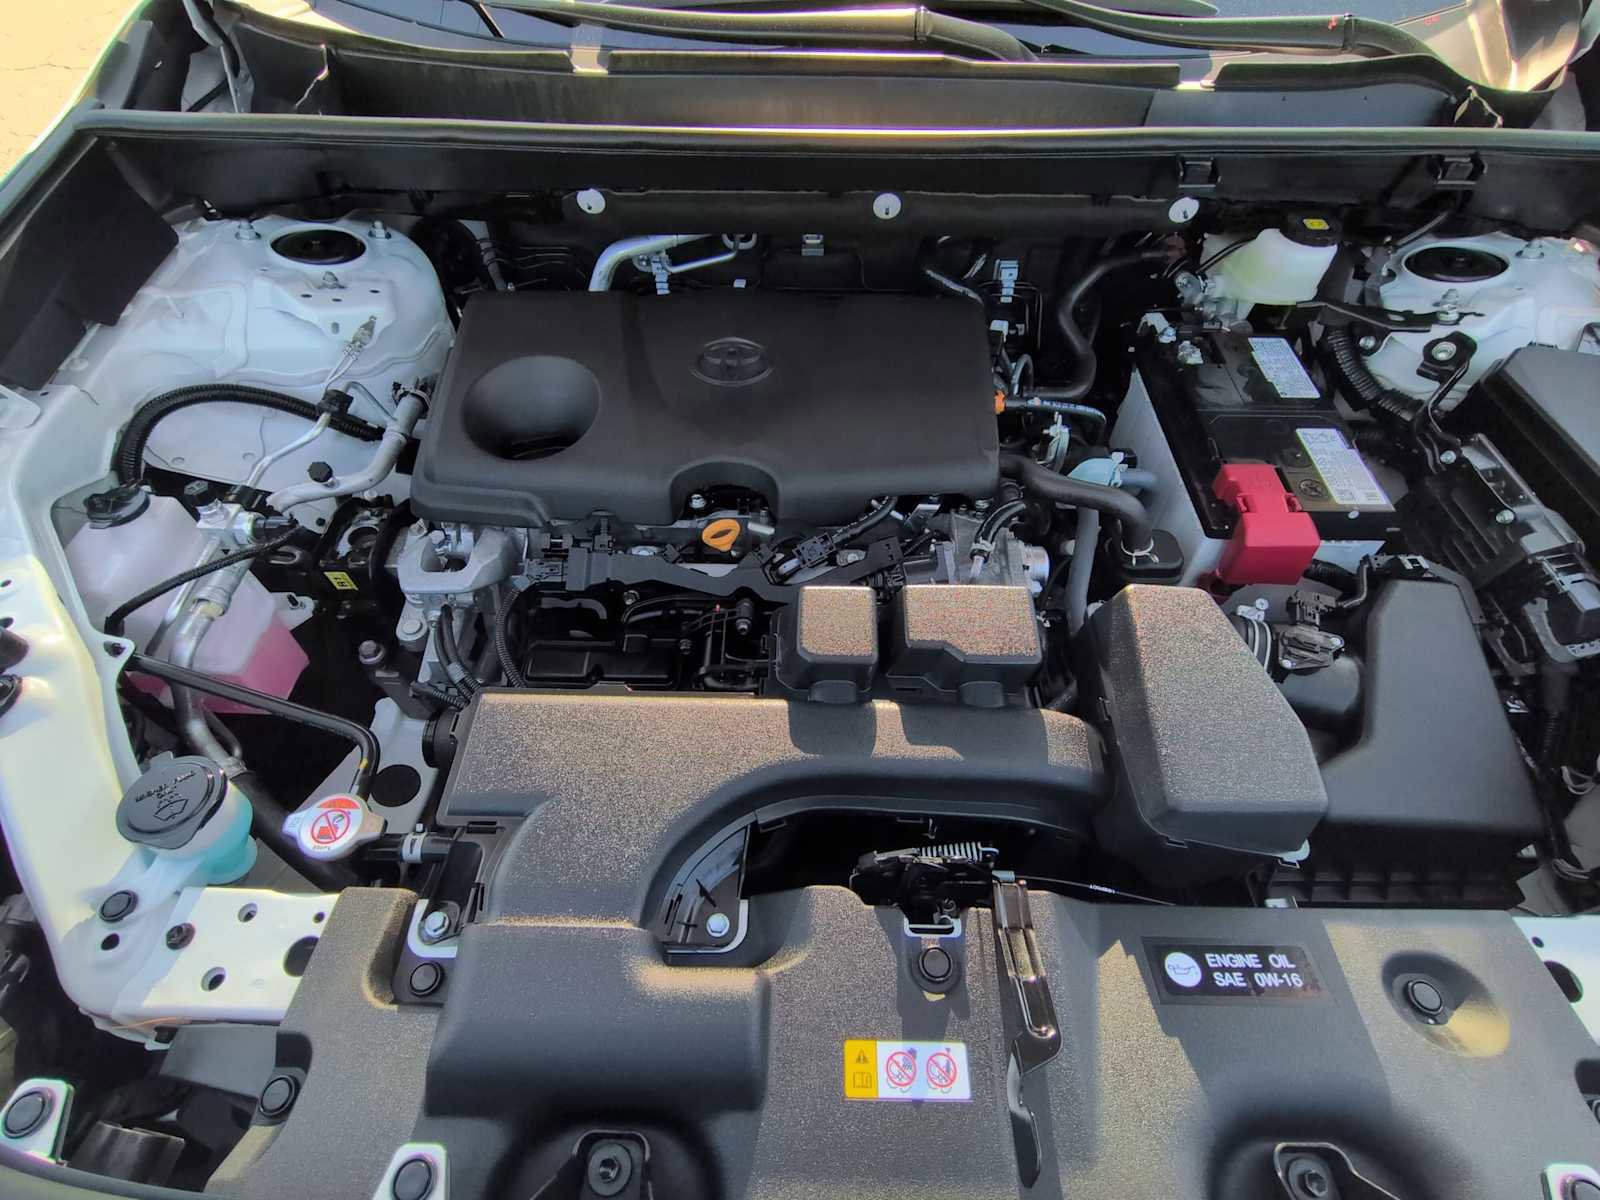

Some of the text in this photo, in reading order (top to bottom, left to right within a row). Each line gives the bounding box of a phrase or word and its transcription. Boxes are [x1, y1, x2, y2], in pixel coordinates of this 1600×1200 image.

[1205, 953, 1296, 968] ENGINE OIL
[1213, 972, 1303, 988] SAE 0W-16
